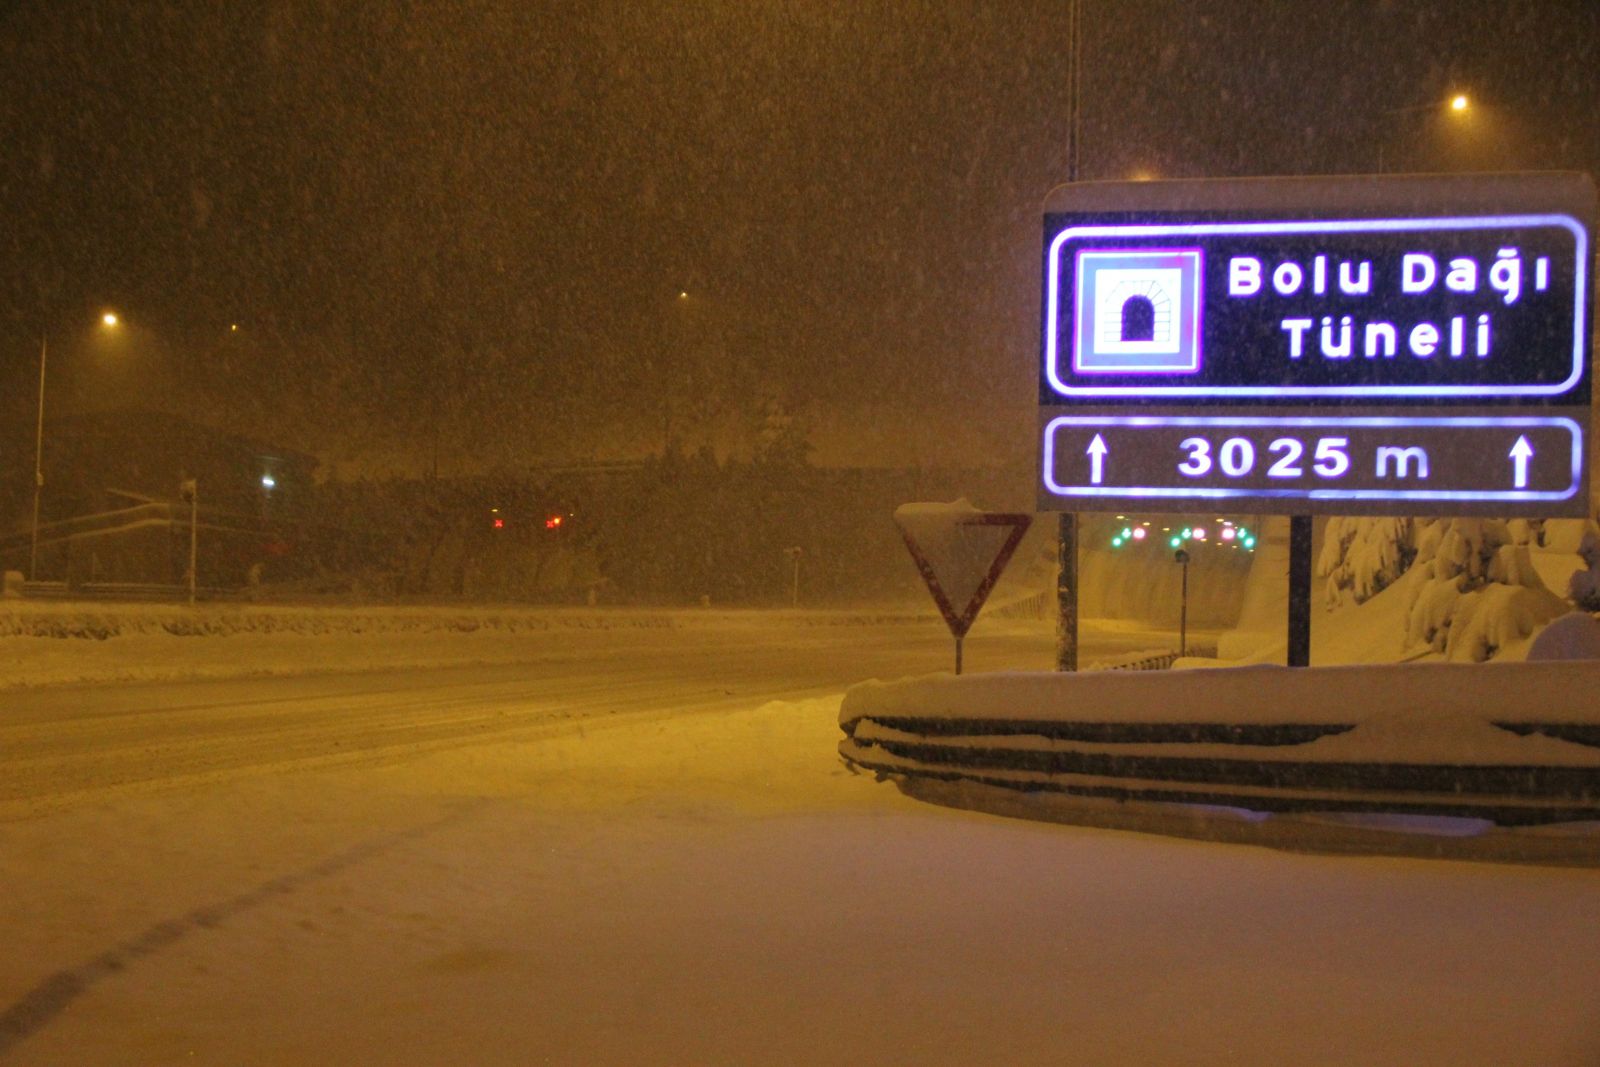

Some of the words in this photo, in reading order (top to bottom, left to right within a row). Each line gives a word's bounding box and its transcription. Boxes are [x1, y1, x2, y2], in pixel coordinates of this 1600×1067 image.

[1228, 255, 1370, 296] Bolu
[1401, 248, 1549, 305] Dağı
[1281, 314, 1489, 358] Tüneli
[1177, 437, 1349, 477] 3025
[1375, 446, 1428, 478] m
